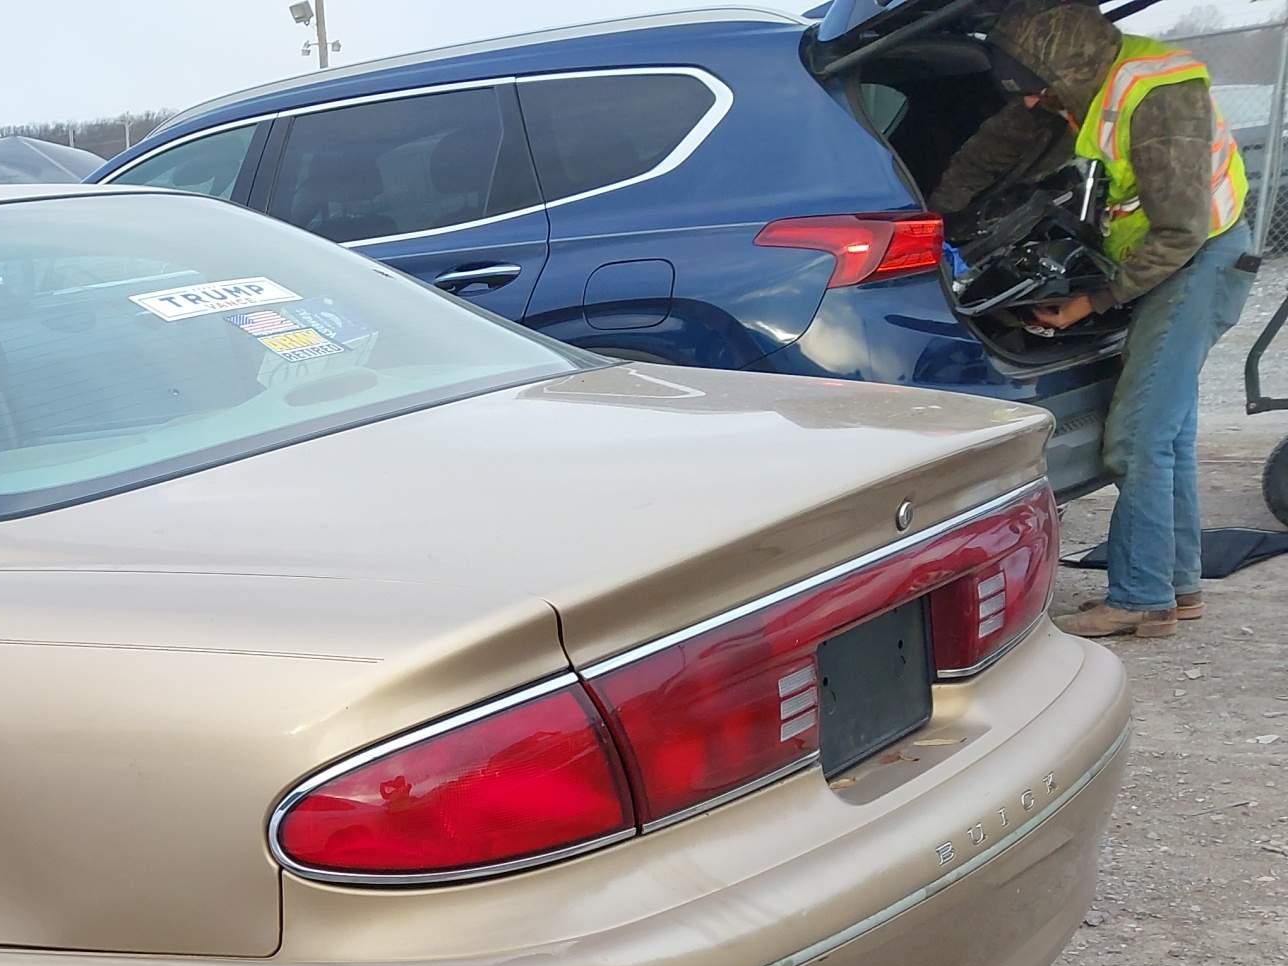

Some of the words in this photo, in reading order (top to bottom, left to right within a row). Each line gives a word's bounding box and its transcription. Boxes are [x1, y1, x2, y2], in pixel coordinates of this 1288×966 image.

[158, 283, 265, 308] TRUMP
[205, 296, 257, 311] VANCE
[282, 344, 342, 361] RETIRED
[935, 771, 1057, 866] BUICK
